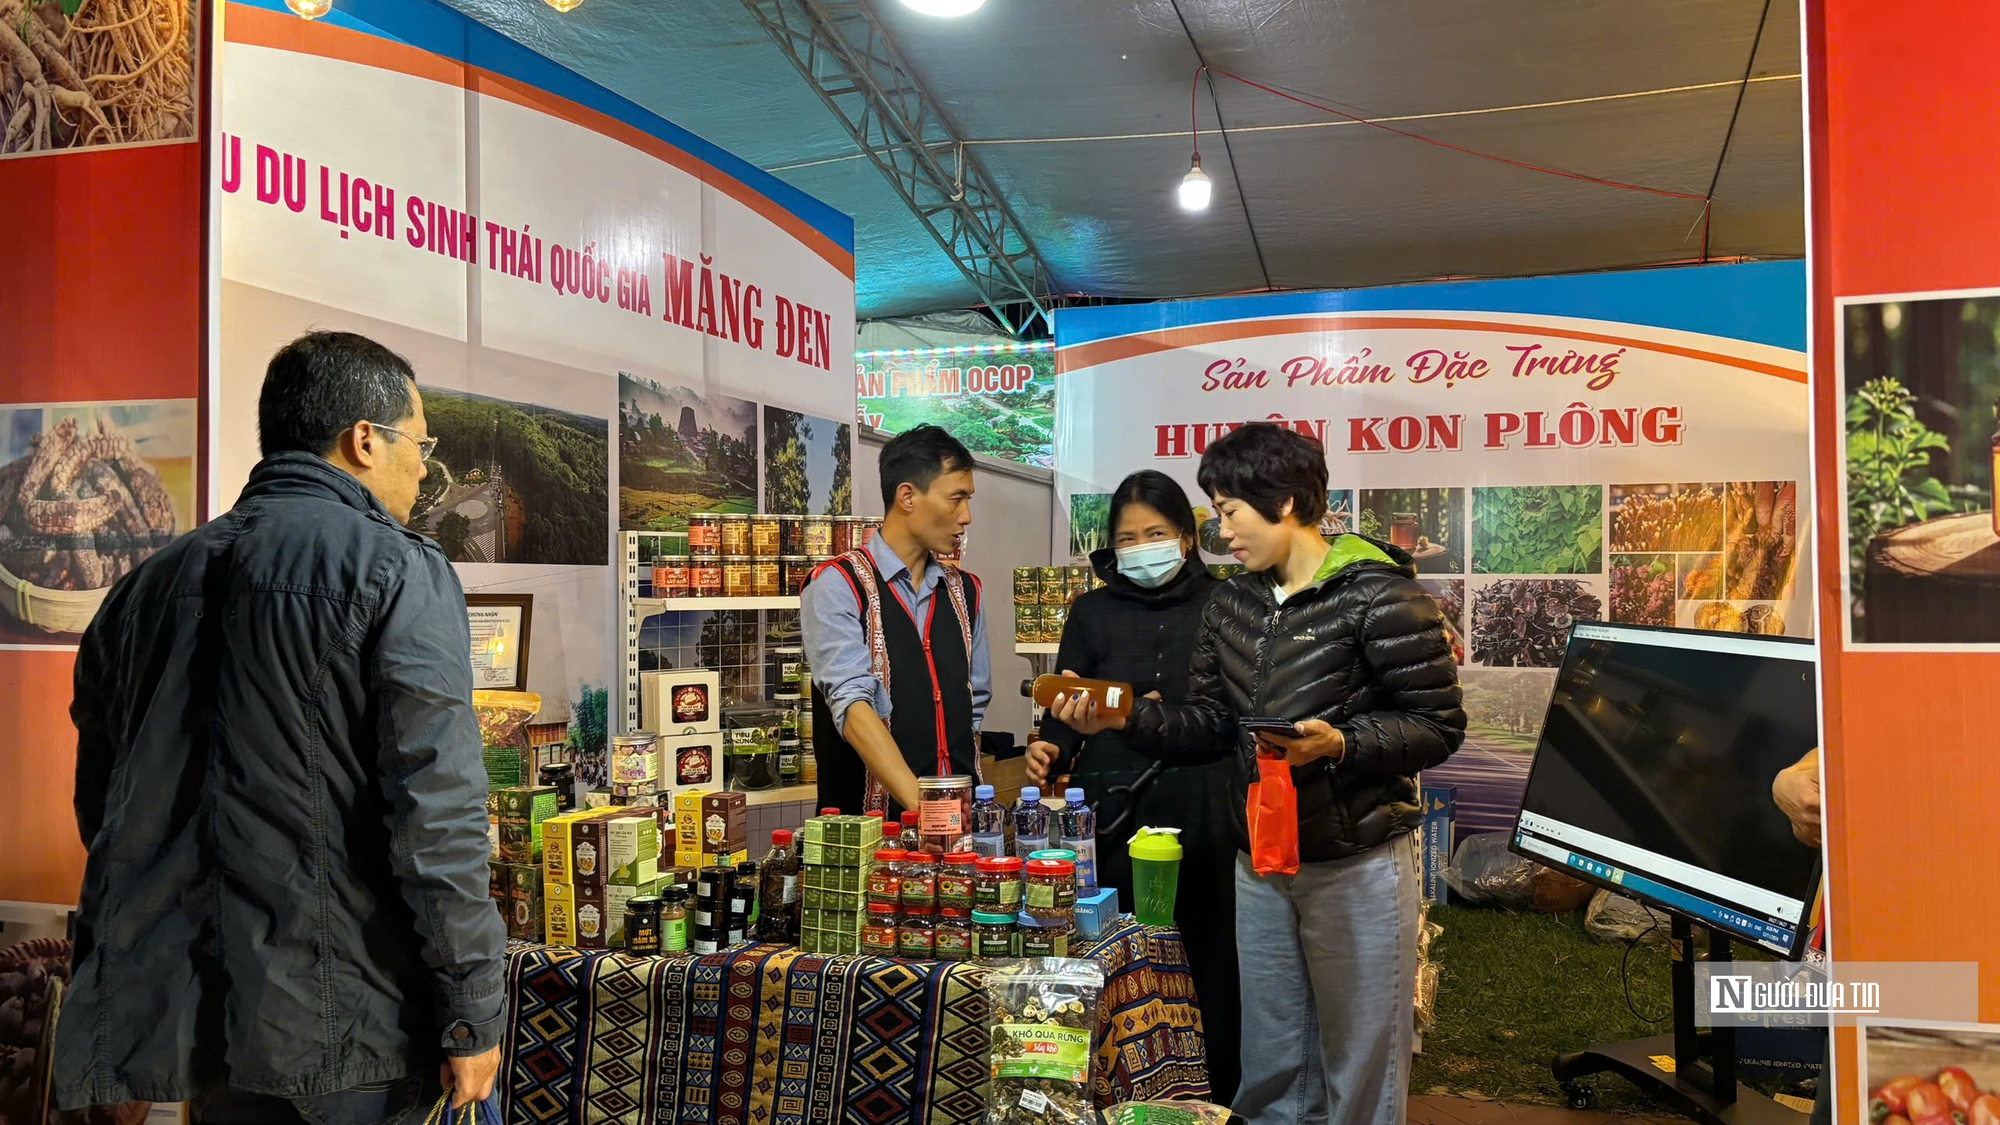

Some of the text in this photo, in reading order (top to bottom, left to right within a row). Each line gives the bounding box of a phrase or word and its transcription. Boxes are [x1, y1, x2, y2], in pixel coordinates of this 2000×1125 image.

[257, 143, 306, 213] DU
[320, 165, 395, 240] LỊCH
[406, 195, 477, 265] SINH
[485, 224, 542, 284] THÁI
[550, 240, 610, 304] QUỐC
[617, 266, 651, 318] GIA
[662, 252, 763, 351] MĂNG
[775, 294, 831, 371] ĐEN
[891, 360, 960, 396] PHẨM
[967, 365, 1032, 394] OCOP
[1201, 343, 1627, 391] Sản Phẩm Đặc Trưng
[1154, 401, 1682, 457] HUN KON PLÔNG
[1035, 1030, 1056, 1040] QUA
